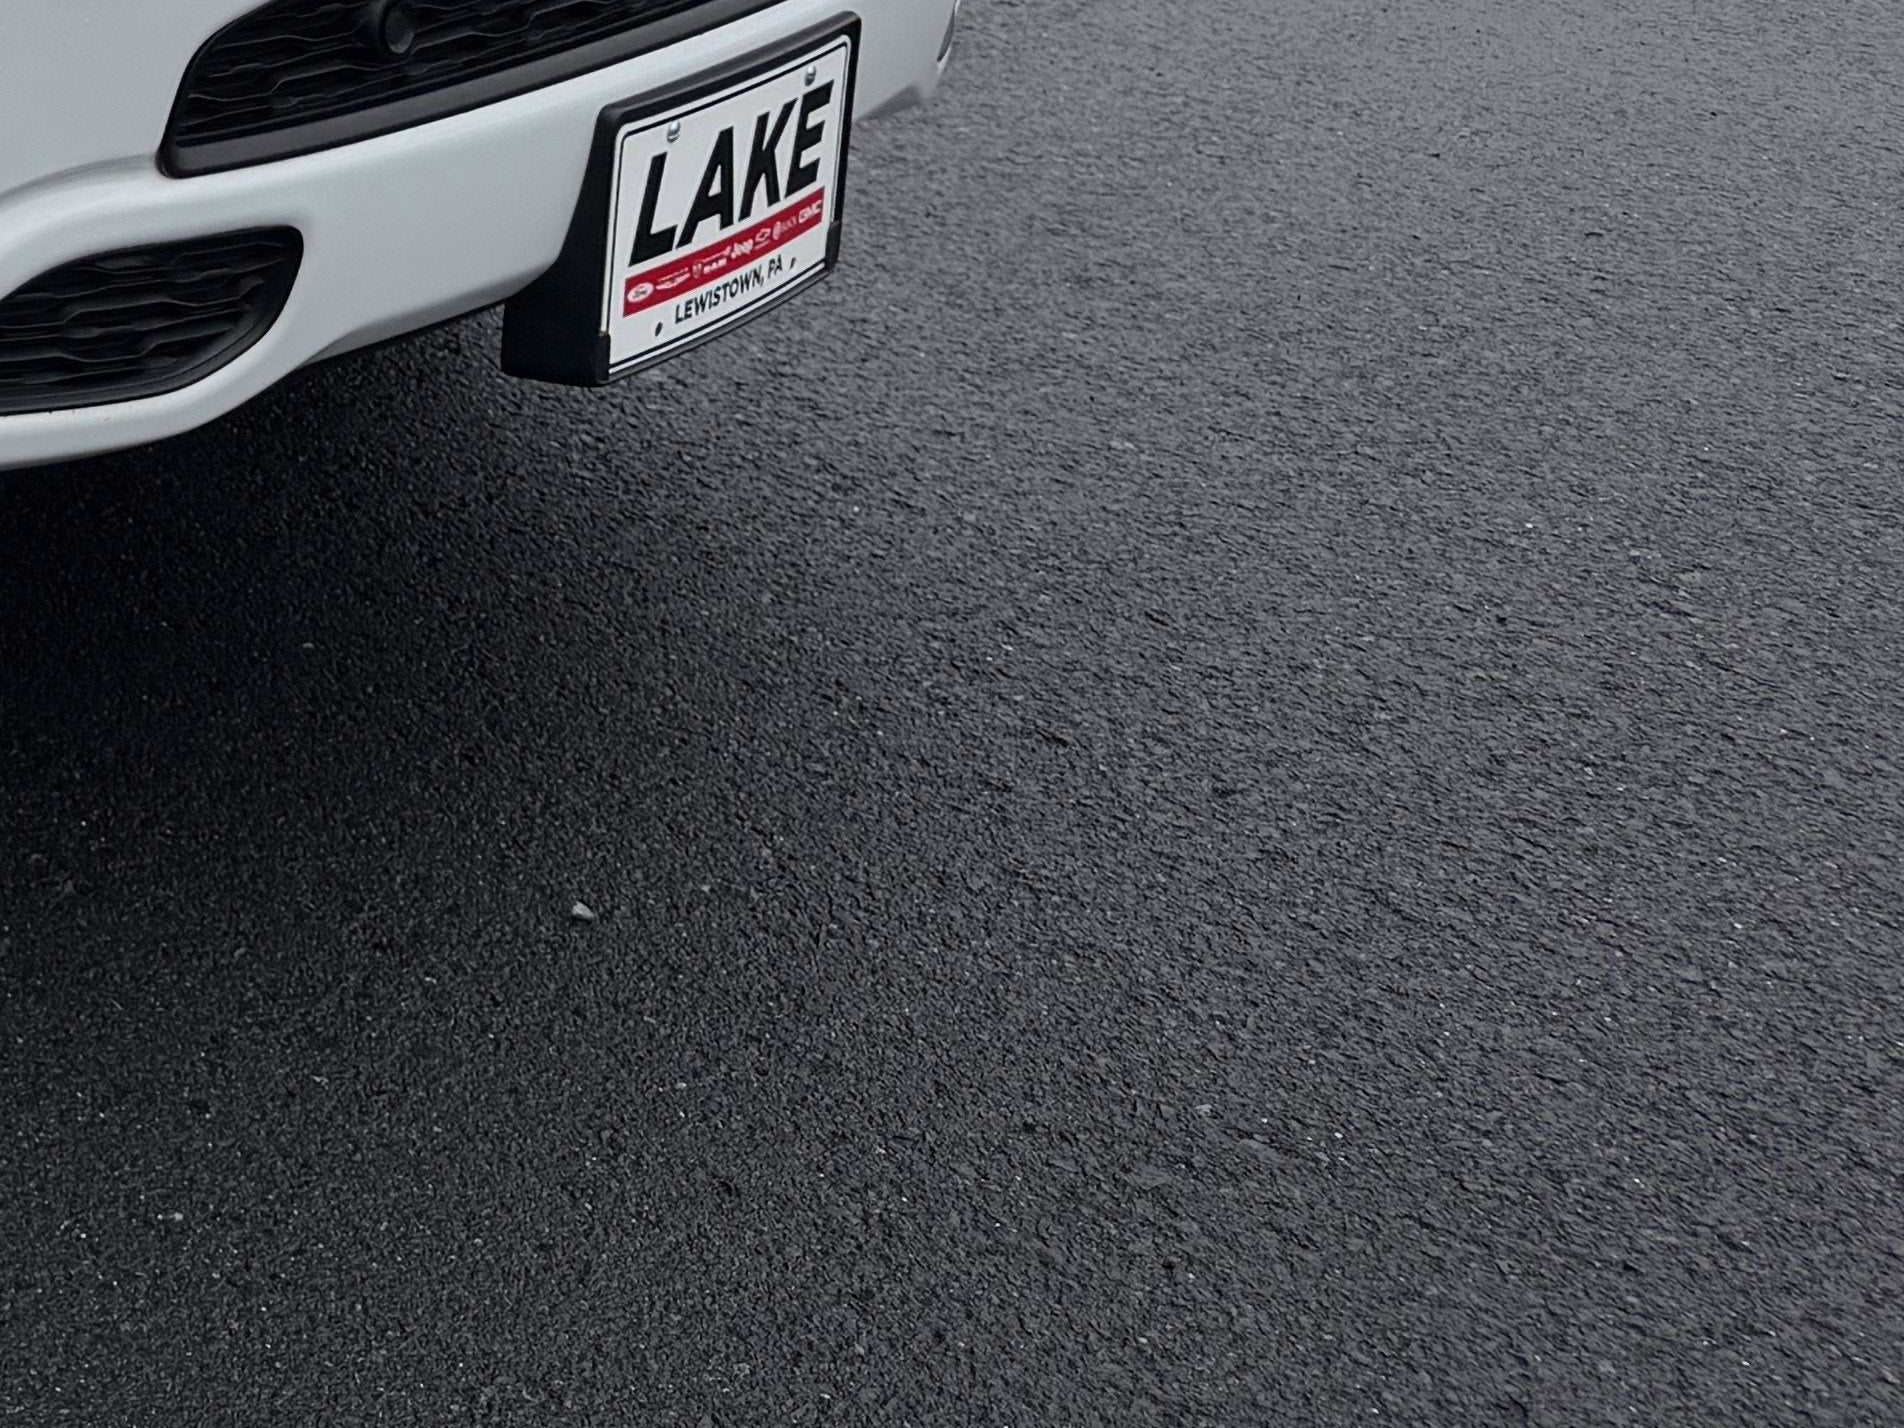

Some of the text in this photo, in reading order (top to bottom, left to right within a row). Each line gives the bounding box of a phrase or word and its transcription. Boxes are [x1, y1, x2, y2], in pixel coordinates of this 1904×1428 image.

[629, 79, 834, 267] LAKE
[675, 263, 764, 324] LEWISTOWN,
[768, 254, 783, 279] PA
